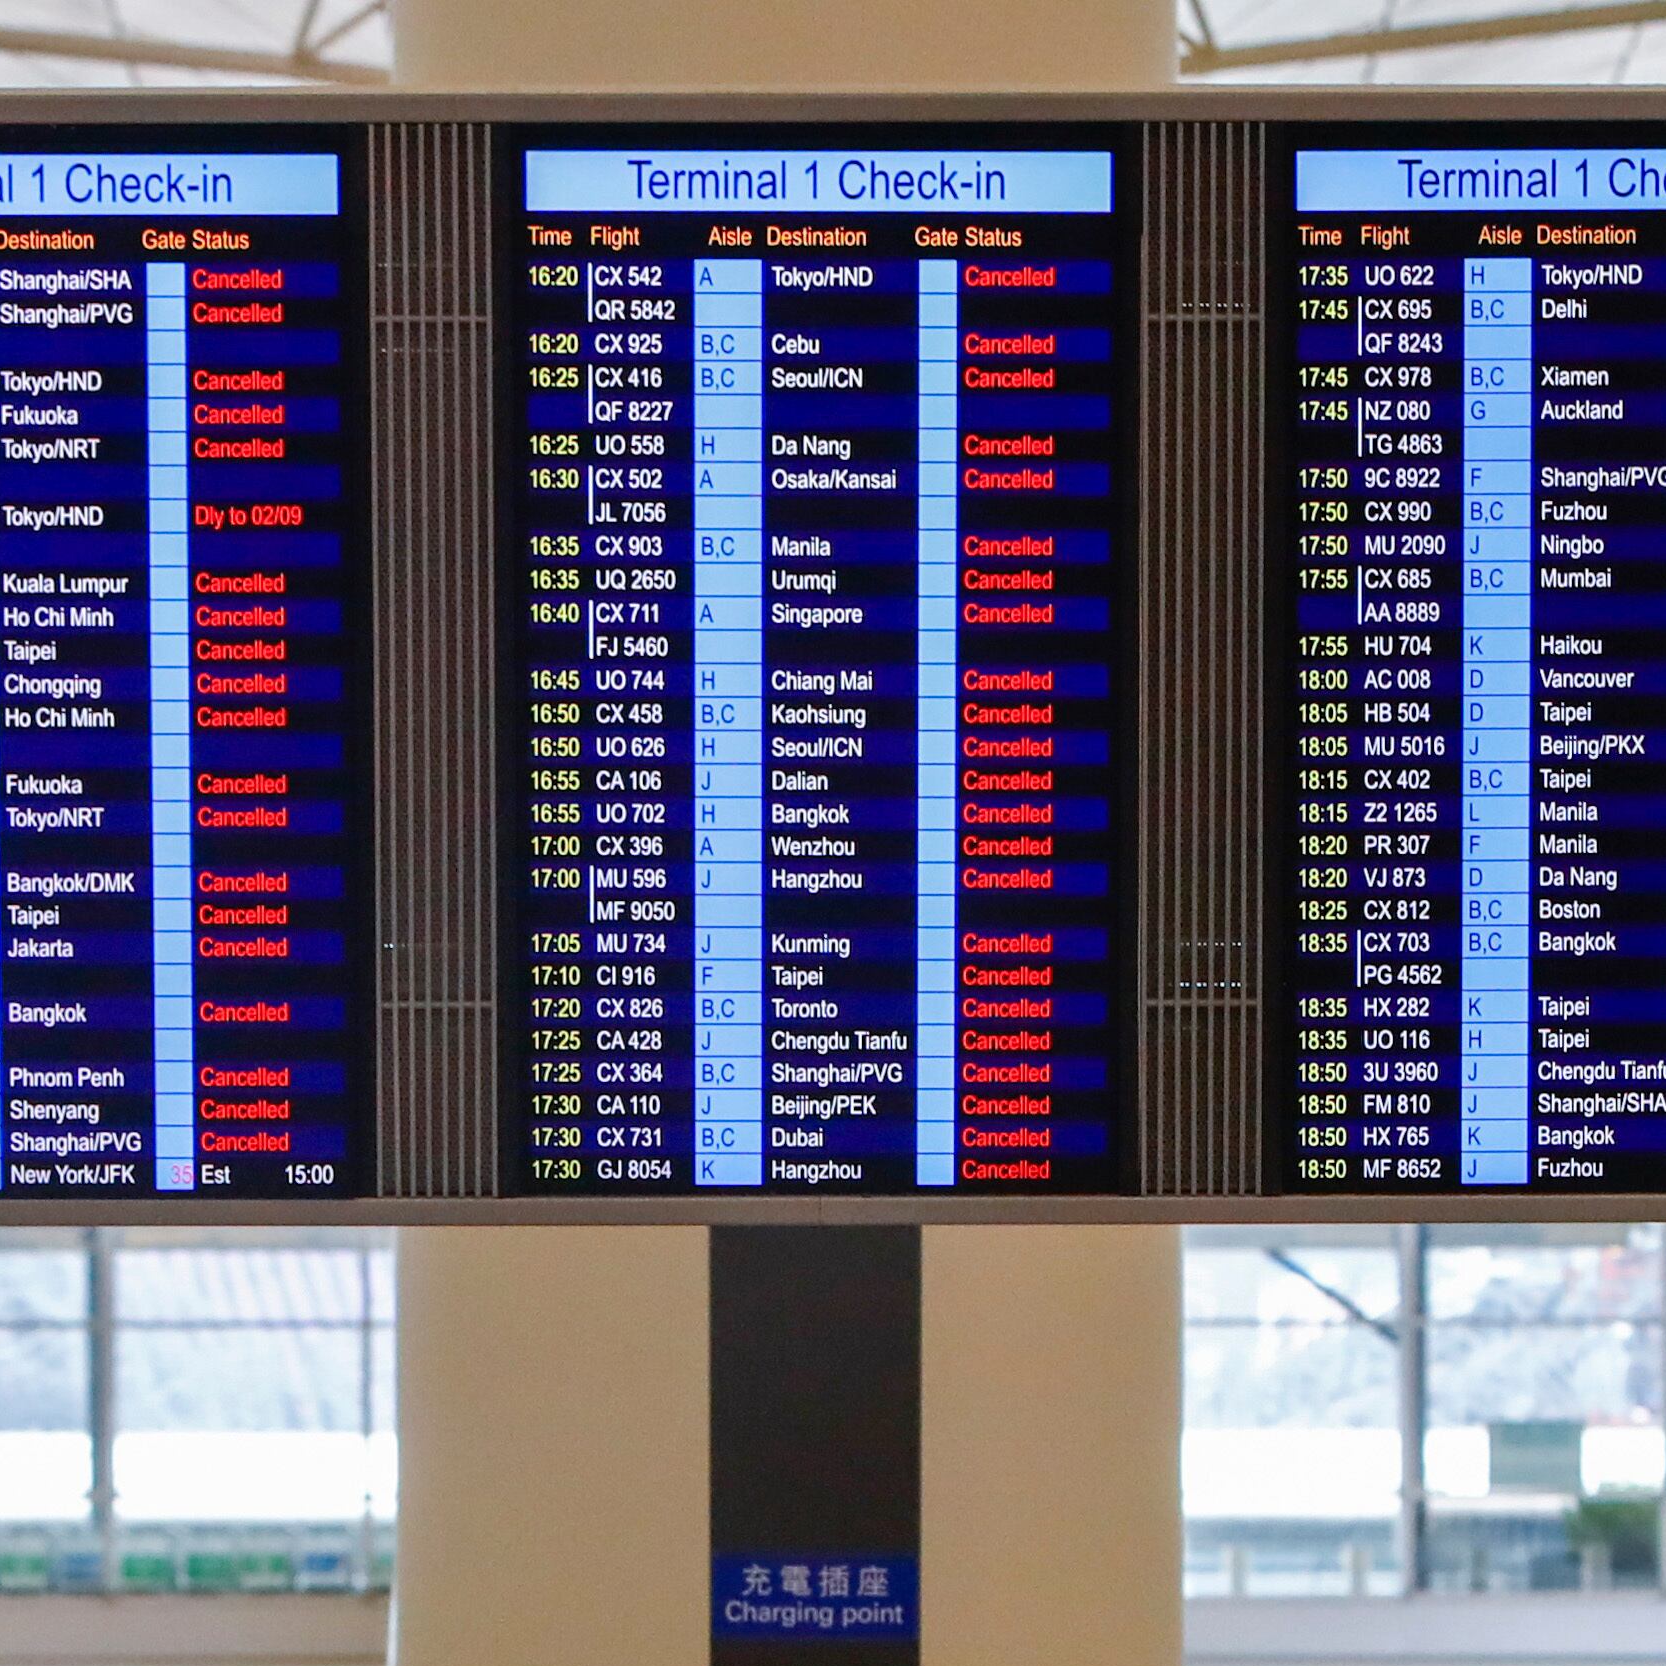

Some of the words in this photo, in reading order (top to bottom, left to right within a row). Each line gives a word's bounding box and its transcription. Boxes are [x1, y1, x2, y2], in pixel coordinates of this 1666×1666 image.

[32, 164, 44, 202] 1
[66, 163, 231, 203] Check-in
[628, 160, 785, 199] Terminal
[806, 161, 817, 199] 1
[839, 160, 1004, 200] Check-in
[1398, 159, 1556, 198] Terminal
[1576, 159, 1587, 197] 1
[142, 229, 186, 249] Gate
[193, 229, 249, 249] Status
[528, 225, 572, 245] Time
[591, 226, 639, 250] Flight
[709, 226, 752, 246] Aisle
[767, 226, 866, 246] Destination
[915, 226, 958, 246] Gate
[965, 226, 1022, 246] Status
[1298, 225, 1342, 245] Time
[1361, 225, 1409, 250] Flight
[1479, 226, 1522, 244] Aisle
[1537, 224, 1636, 244] Destination
[530, 334, 578, 353] 16:20
[595, 333, 623, 353] CX
[628, 334, 662, 353] 925
[702, 334, 734, 355] B,C
[772, 334, 819, 354] Cebu
[964, 333, 1055, 354] Cancelled
[1300, 468, 1347, 488] 17:50
[1365, 468, 1390, 488] 9C
[1396, 468, 1440, 487] 8922
[1471, 468, 1481, 486] F
[2, 506, 103, 530] Tokyo/HND
[195, 505, 225, 530] Dly
[228, 507, 246, 525] to
[252, 505, 303, 525] 02/09
[532, 836, 580, 855] 17:00
[596, 836, 624, 855] CX
[630, 836, 663, 855] 396
[700, 837, 713, 855] A
[772, 837, 855, 855] Wenzhou
[963, 836, 1053, 855] Cancelled
[1299, 901, 1347, 920] 18:25
[1364, 900, 1391, 919] CX
[1397, 900, 1429, 919] 812
[1469, 900, 1501, 920] B,C
[1540, 899, 1600, 918] Boston
[11, 1165, 49, 1183] New
[54, 1164, 134, 1184] York/JFK
[170, 1165, 193, 1184] 35
[202, 1164, 230, 1184] Est
[286, 1165, 334, 1184] 15:00
[533, 1160, 580, 1178] 17:30
[598, 1160, 622, 1179] GJ
[628, 1160, 671, 1179] 8054
[702, 1161, 714, 1179] K
[772, 1160, 861, 1183] Hangzhou
[962, 1160, 1050, 1179] Cancelled
[1299, 1159, 1346, 1178] 18:50
[1364, 1159, 1391, 1178] MF
[1397, 1159, 1440, 1178] 8652
[1467, 1159, 1476, 1178] J
[1538, 1158, 1603, 1177] Fuzhou
[743, 1564, 887, 1597] 充電插座
[725, 1600, 833, 1628] Charging
[842, 1603, 902, 1627] point
